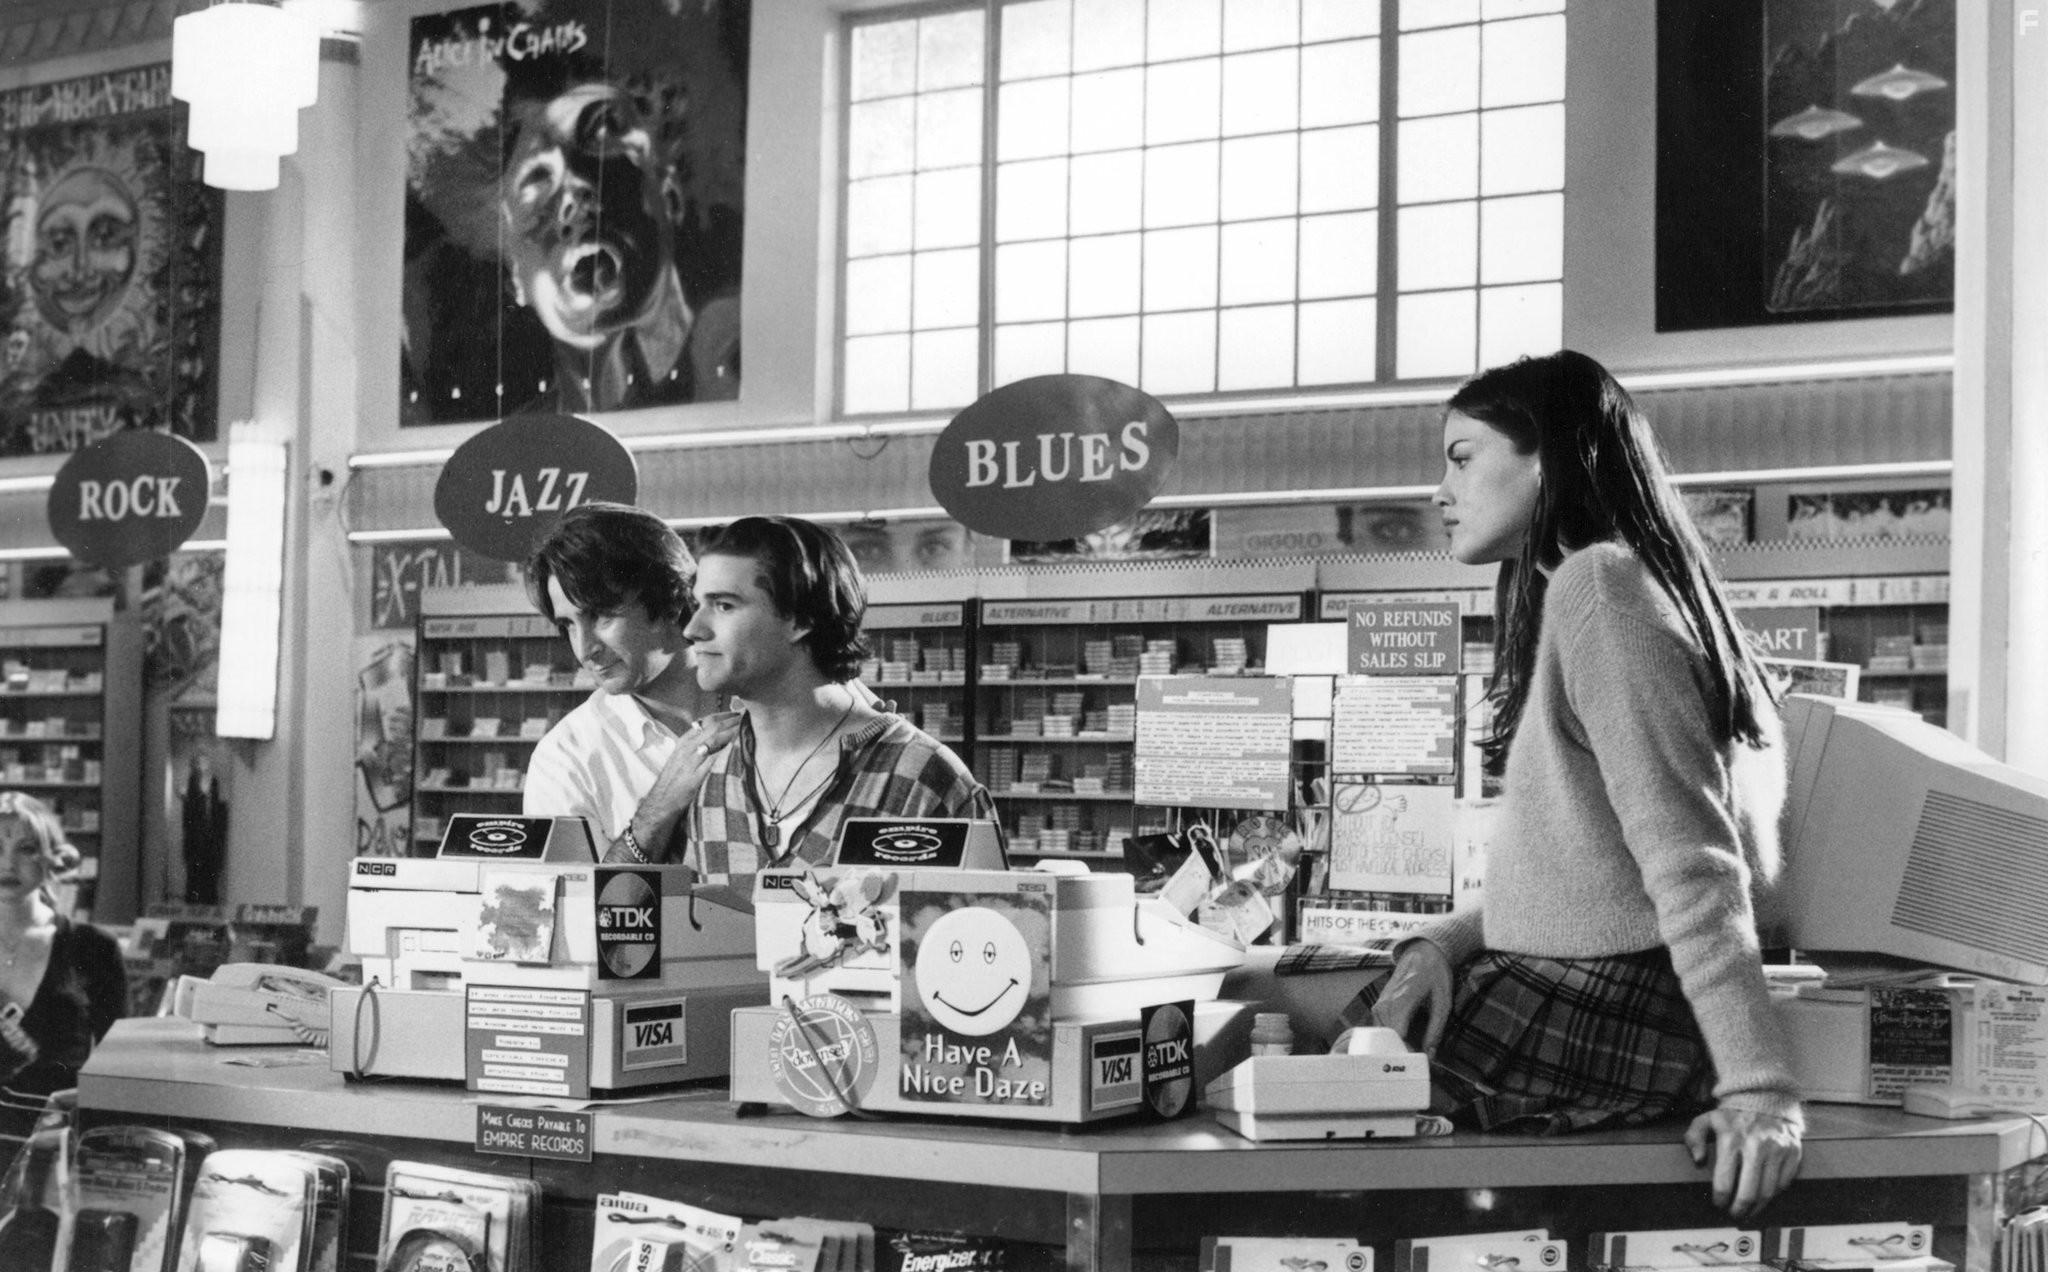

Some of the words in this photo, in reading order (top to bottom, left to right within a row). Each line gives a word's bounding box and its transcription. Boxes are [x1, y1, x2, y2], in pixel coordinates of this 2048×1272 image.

[965, 421, 1150, 488] BLUES
[79, 474, 182, 521] ROCK
[486, 467, 589, 517] JAZZ
[921, 611, 960, 623] BLUES
[988, 608, 1071, 620] ALTERNATIVE
[1206, 602, 1297, 616] ALTERNATIVE
[1355, 611, 1376, 627] NO
[1383, 610, 1453, 627] REFUNDS
[1369, 631, 1438, 647] WITHOUT
[1360, 652, 1408, 668] SALES
[1414, 652, 1447, 668] SLIP
[476, 820, 525, 830] empire
[878, 825, 937, 835] empire
[470, 843, 522, 854] records
[874, 851, 937, 862] records
[357, 863, 396, 876] NCR
[611, 907, 655, 928] TDK
[1307, 916, 1333, 929] HITS
[1335, 916, 1354, 929] OF
[1358, 918, 1377, 931] THE
[601, 933, 643, 941] RECORDABLE
[645, 933, 655, 941] CD
[635, 1022, 673, 1047] VISA
[926, 1034, 993, 1066] Have
[1002, 1037, 1023, 1064] A
[1156, 1039, 1188, 1065] TDK
[1102, 1057, 1132, 1085] VISA
[1148, 1067, 1181, 1082] RECORDABLE
[903, 1064, 966, 1097] Nice
[975, 1067, 1047, 1099] Daze
[482, 1111, 503, 1127] MAKE
[507, 1113, 533, 1129] CHECKS
[538, 1115, 571, 1133] PAYABLE
[576, 1118, 586, 1134] TO
[483, 1130, 525, 1149] EMPIRE
[531, 1134, 584, 1154] RECORDS
[600, 1197, 648, 1213] aiwa
[749, 1250, 796, 1265] Classic
[902, 1249, 978, 1272] Energizer
